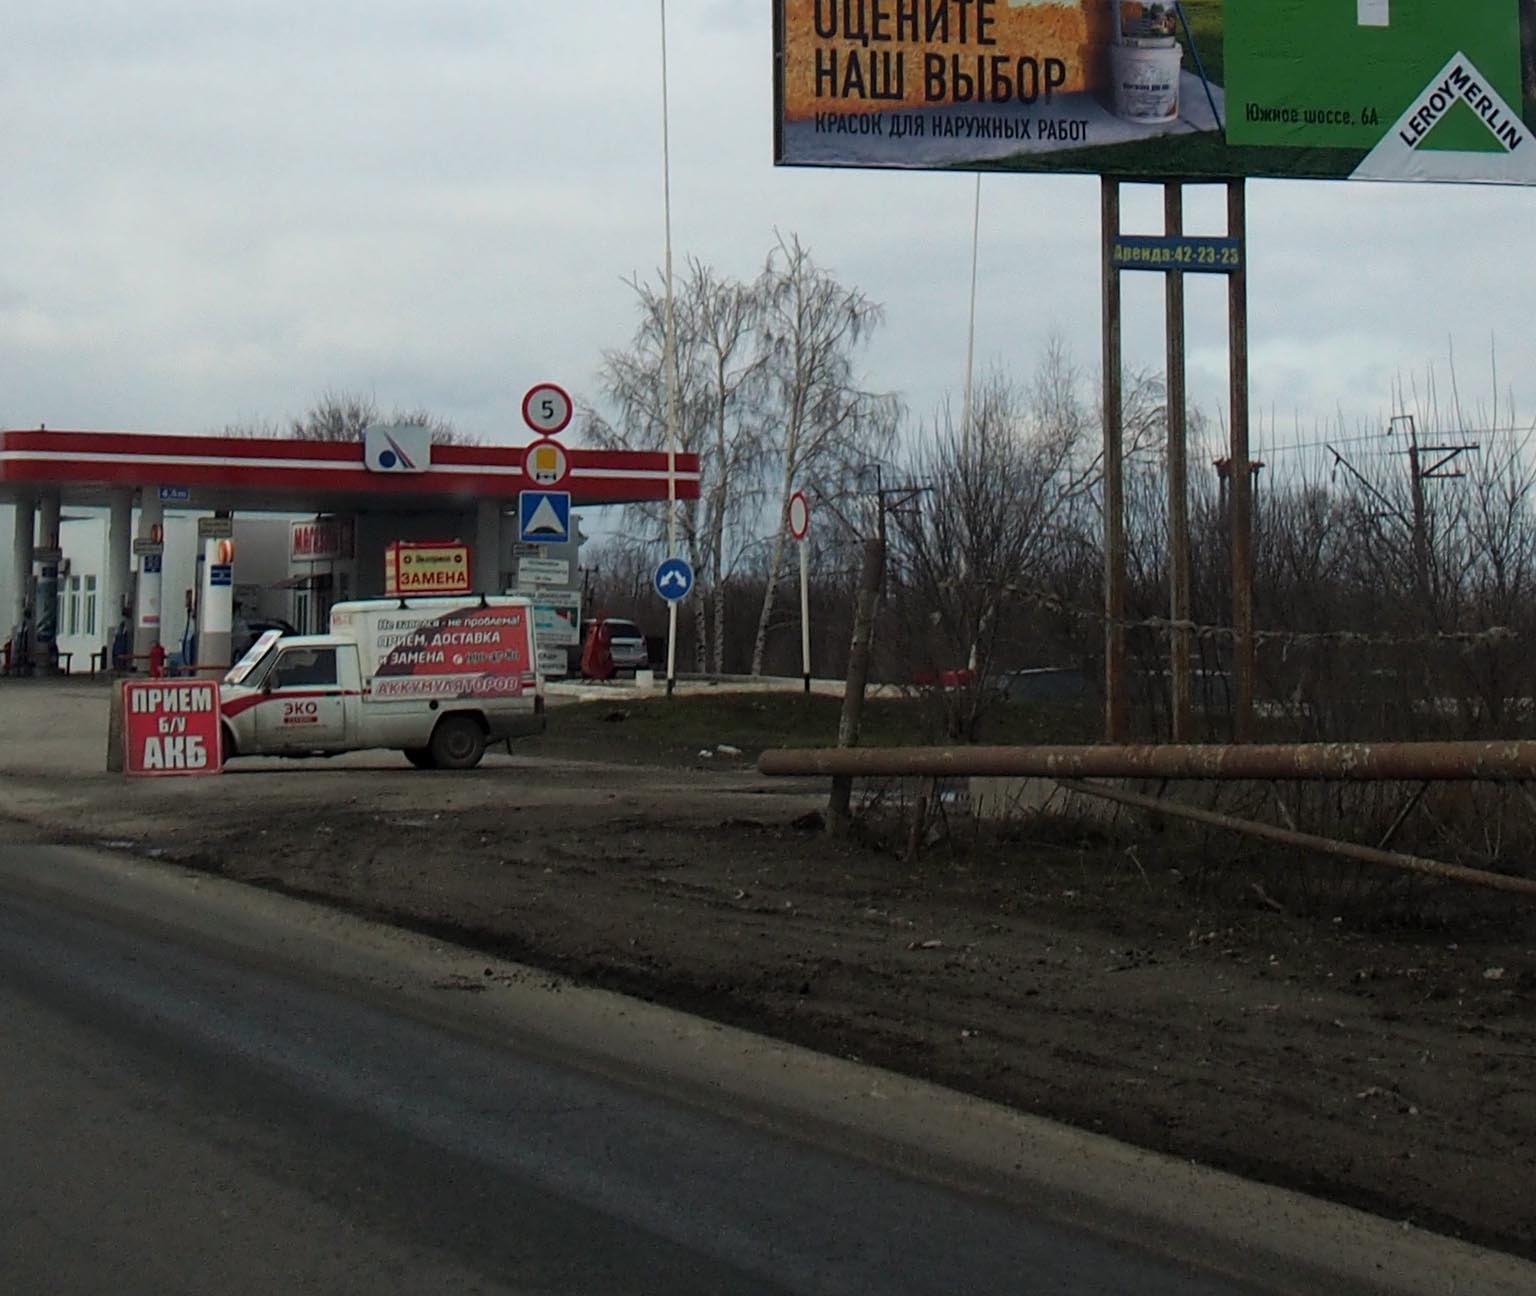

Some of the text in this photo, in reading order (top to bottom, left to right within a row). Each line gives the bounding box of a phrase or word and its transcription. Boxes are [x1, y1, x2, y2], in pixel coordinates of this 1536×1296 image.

[815, 48, 1066, 105] НАШ ВЫБОР
[1246, 103, 1299, 123] Южное
[1399, 79, 1455, 148] LEROY
[1449, 65, 1523, 151] MERLIN
[815, 111, 1088, 141] КРАСОК ДЛЯ НАРУЖНЫХ РАБОТ
[542, 400, 554, 420] 5
[400, 571, 466, 586] ЗАМЕНА
[431, 631, 500, 647] ДОСТАВКА
[391, 652, 445, 665] ЗАМЕНА
[377, 677, 519, 695] АККУМУЛЯТОРОВ
[131, 687, 212, 714] ПРИЕМ
[284, 702, 318, 715] ЭКО
[143, 735, 208, 769] АКБ
